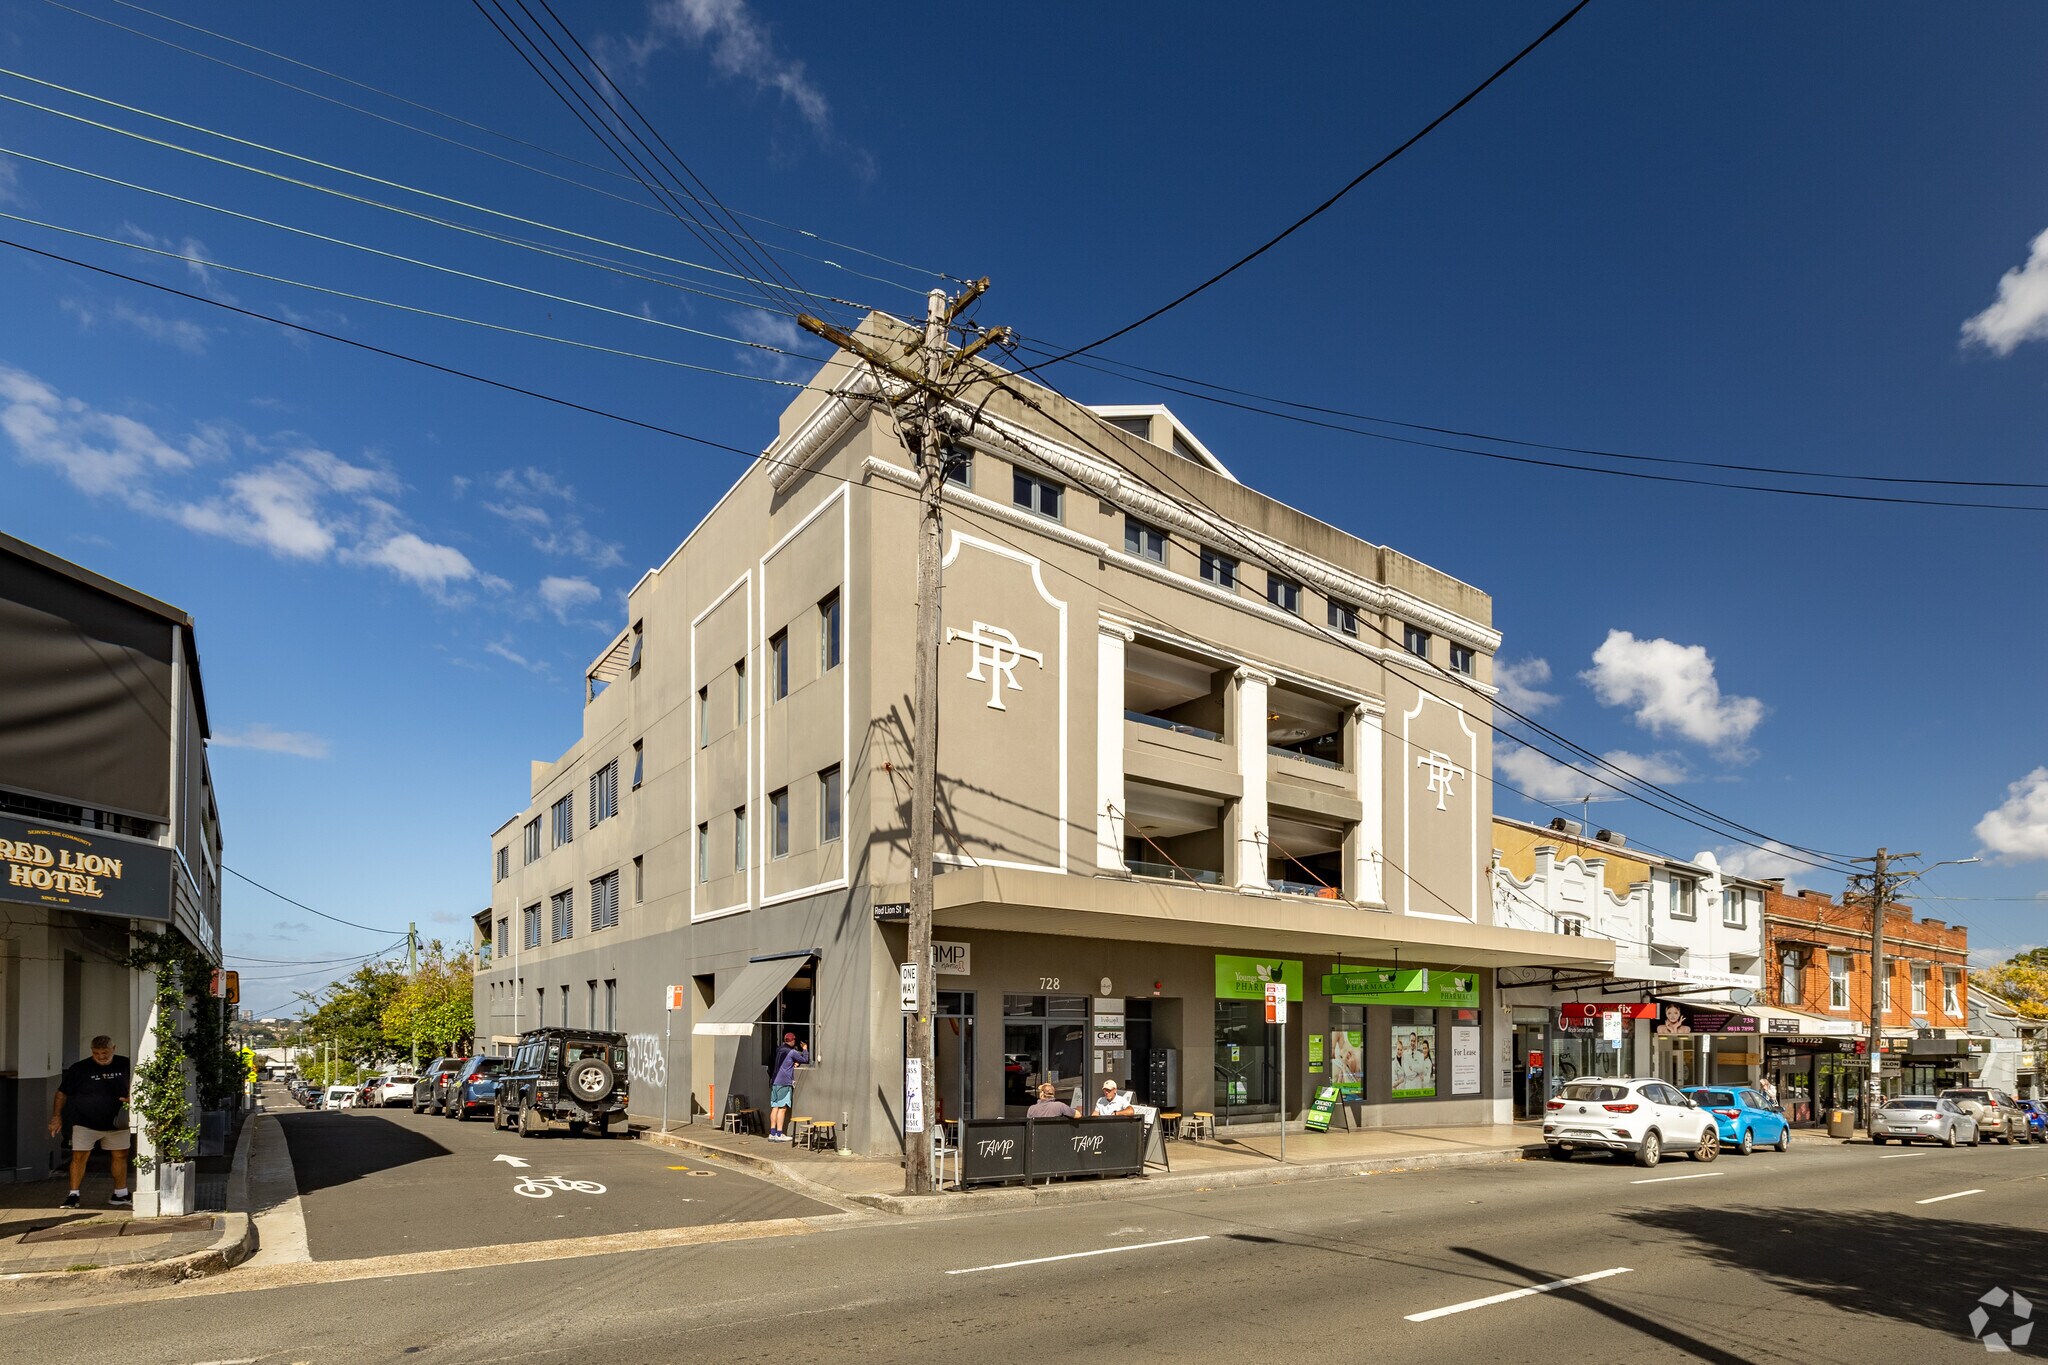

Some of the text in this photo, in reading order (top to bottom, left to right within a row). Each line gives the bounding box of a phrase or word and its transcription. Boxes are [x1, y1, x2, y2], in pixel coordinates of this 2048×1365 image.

[59, 849, 123, 879] LION
[9, 864, 104, 899] HOTEL
[874, 906, 884, 915] Red
[884, 906, 896, 914] Lion
[895, 905, 902, 914] St
[932, 945, 965, 963] AMP
[903, 968, 916, 979] ONE
[1235, 971, 1258, 984] Youngs
[1039, 977, 1060, 990] 728
[1236, 982, 1266, 992] PHARM
[1345, 977, 1368, 986] Youngs
[1346, 982, 1397, 991] PHARMACY
[902, 983, 916, 994] WAY
[1440, 992, 1473, 1001] PHARMACY
[1097, 1032, 1122, 1040] Celtic
[1453, 1048, 1476, 1056] For Lease
[977, 1139, 1014, 1158] TAMP
[1071, 1135, 1104, 1153] TAMP
